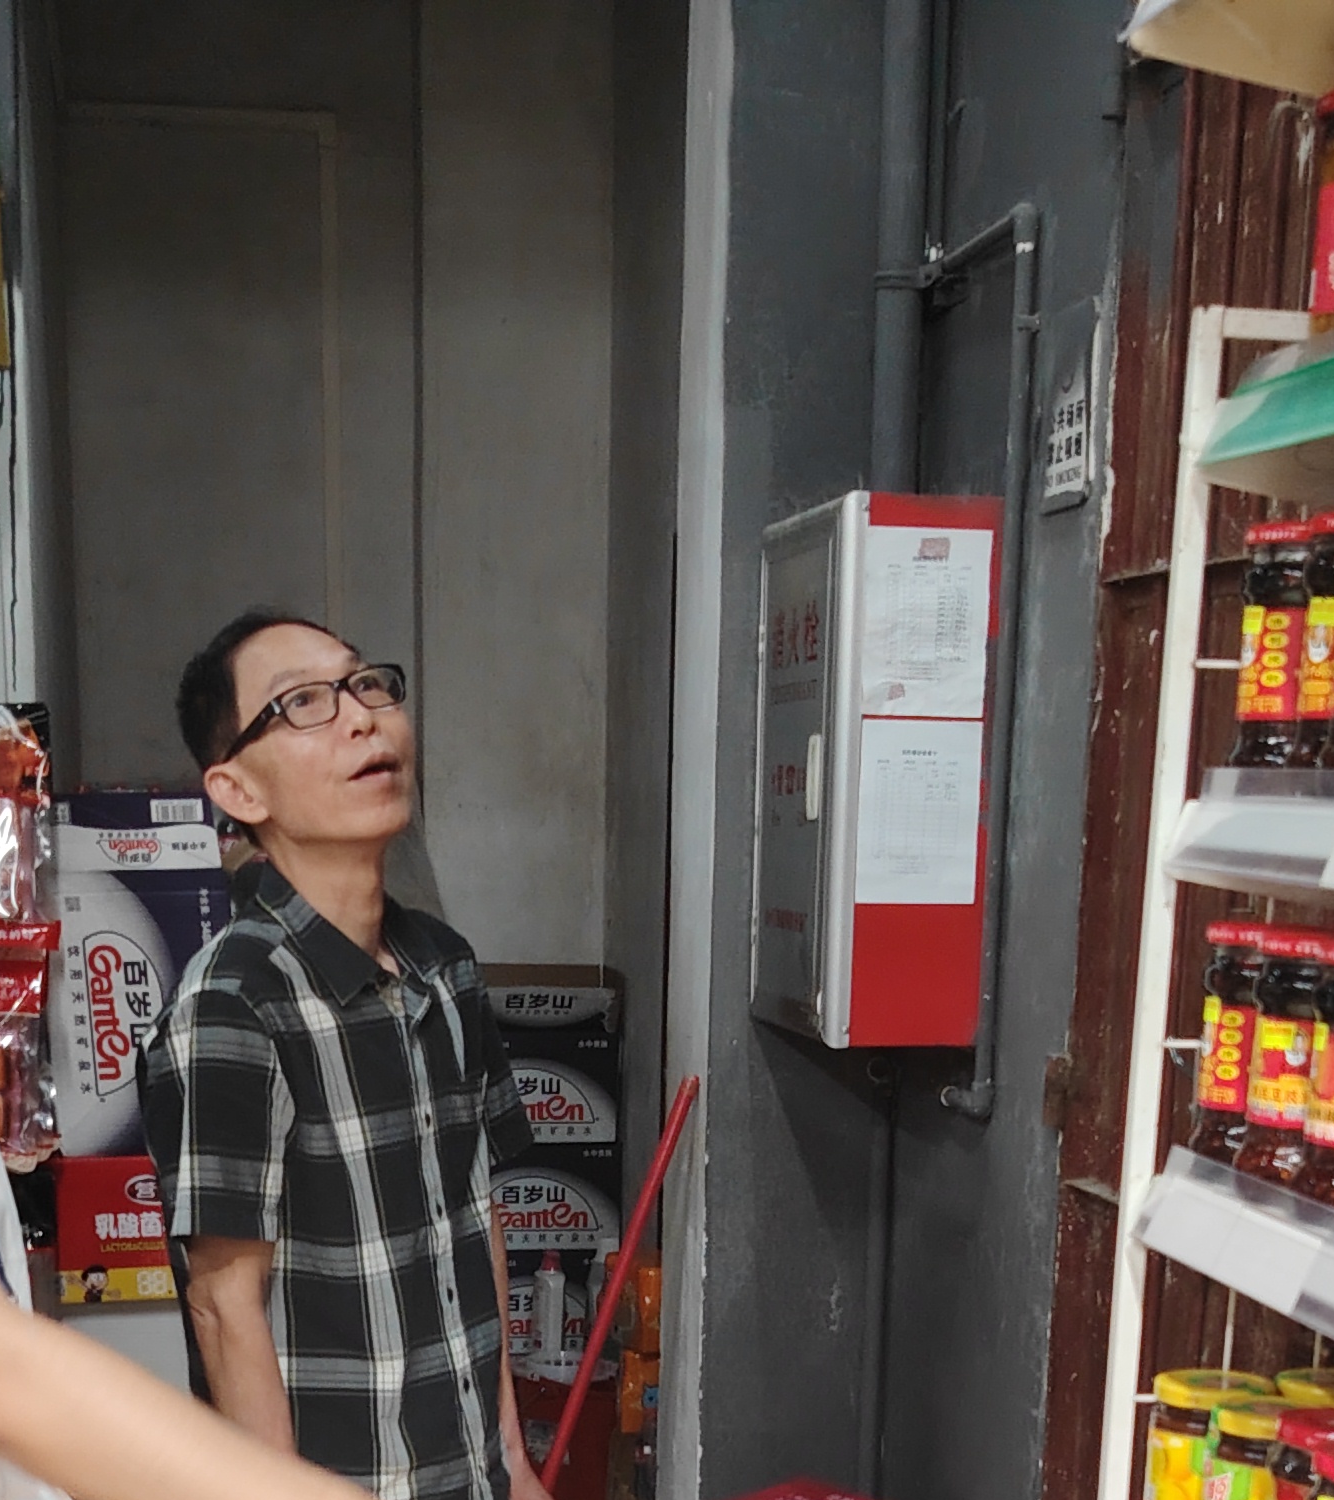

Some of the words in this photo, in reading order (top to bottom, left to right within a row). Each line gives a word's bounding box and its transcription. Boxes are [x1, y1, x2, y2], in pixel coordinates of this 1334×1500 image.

[88, 944, 131, 1081] Ganten
[505, 992, 573, 1010] 百岁山
[501, 1185, 567, 1204] 百岁山
[95, 1211, 165, 1240] 乳酸菌
